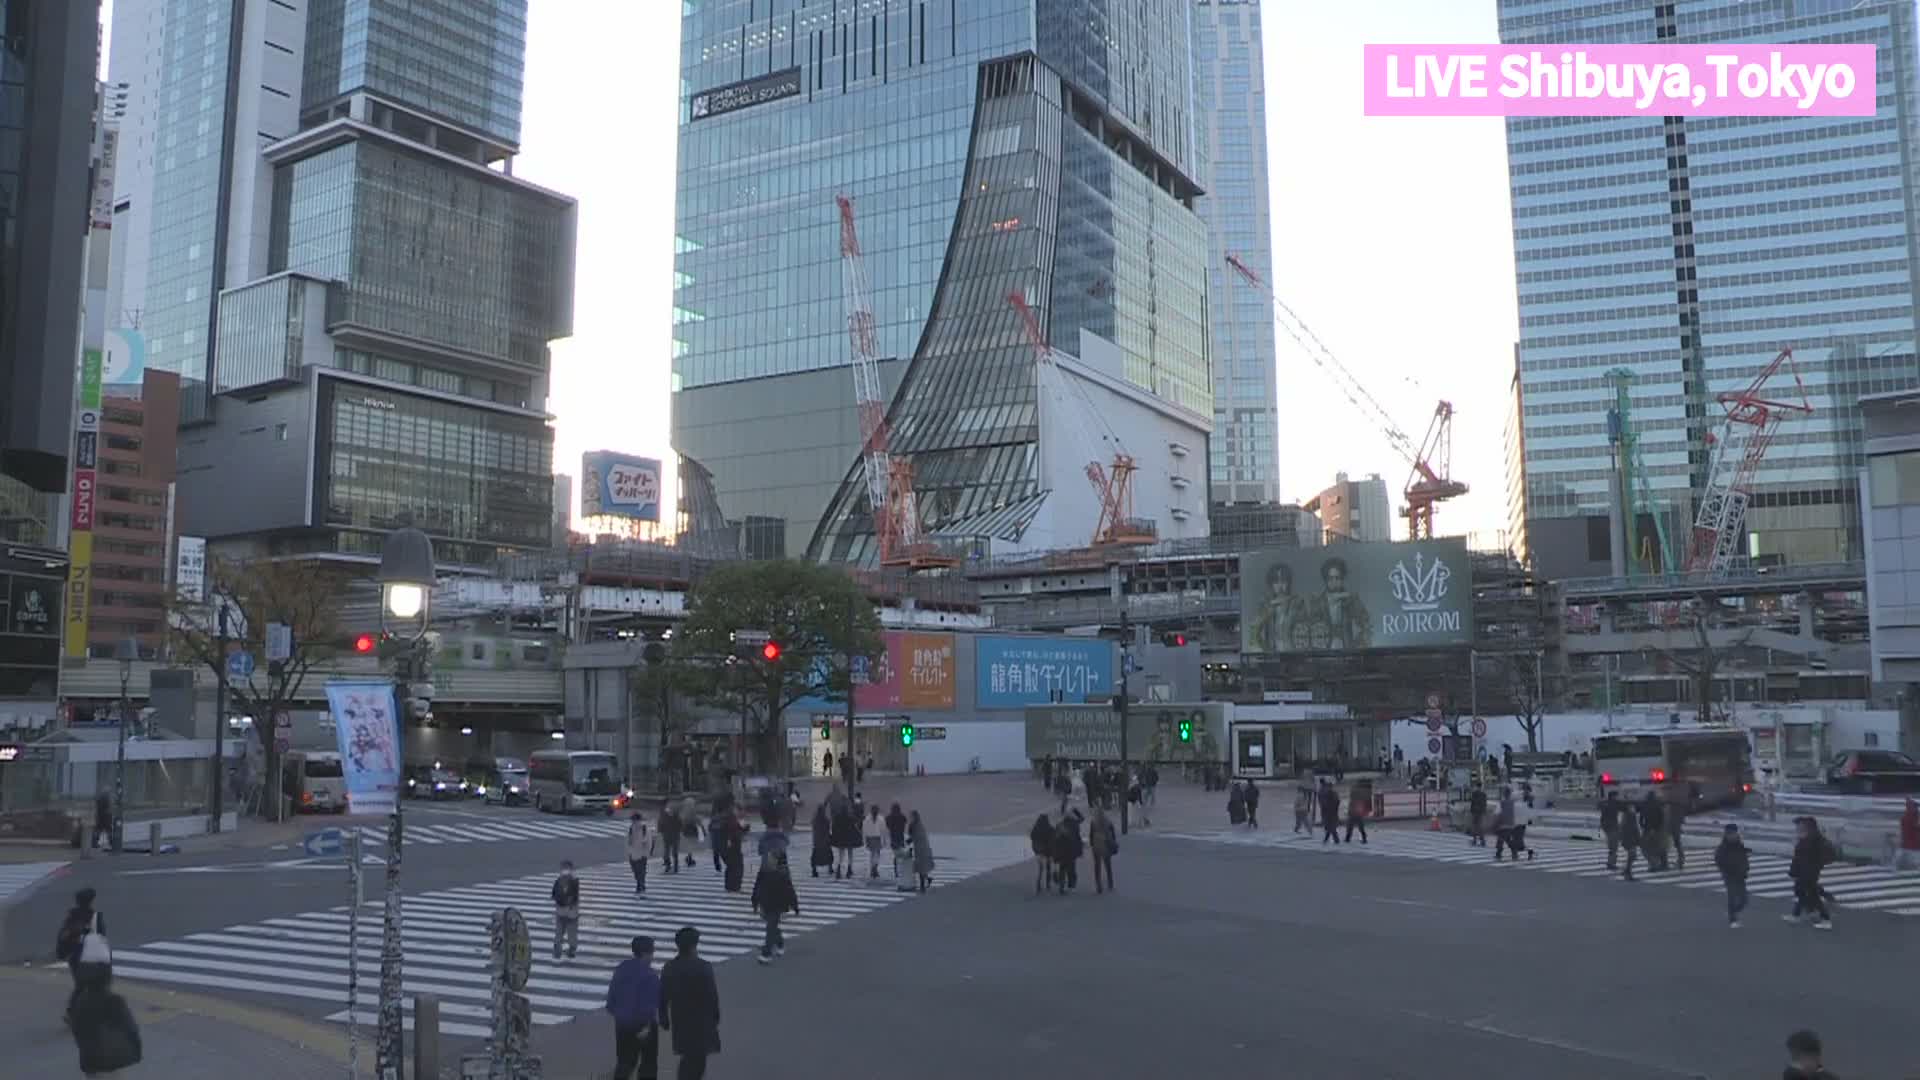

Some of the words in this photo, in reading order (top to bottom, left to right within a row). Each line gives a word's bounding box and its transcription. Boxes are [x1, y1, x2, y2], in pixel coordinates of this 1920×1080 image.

[711, 91, 757, 111] SCRAMBLE
[759, 81, 798, 101] SQUARE
[614, 471, 652, 486] ファイト
[71, 567, 88, 623] プロミス
[1383, 611, 1460, 635] ROIROM
[991, 663, 1099, 693] 龍角散ダイレクト
[1087, 741, 1120, 757] DIVA
